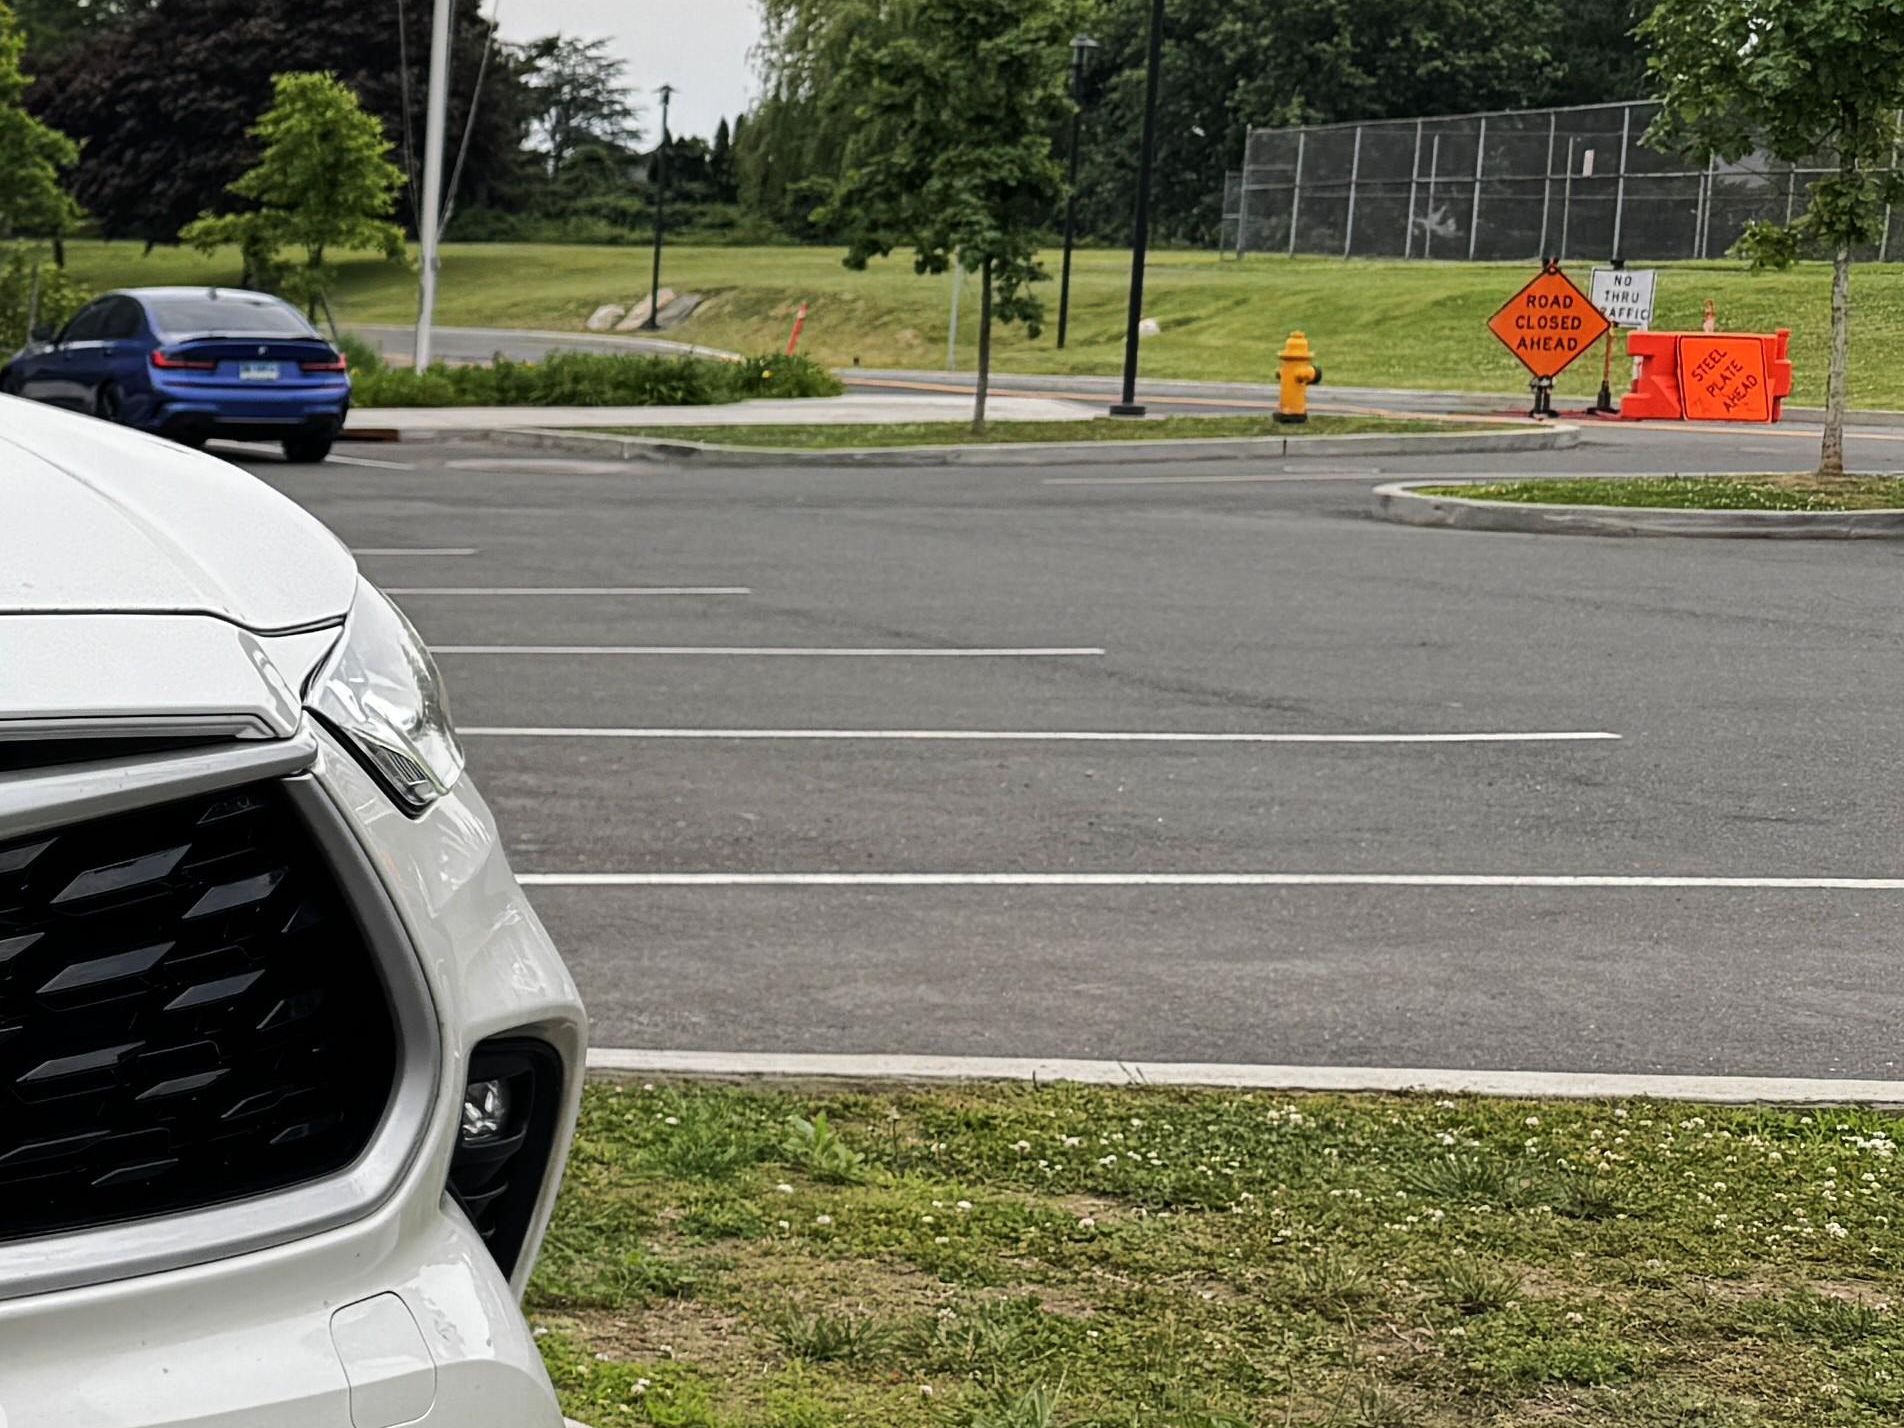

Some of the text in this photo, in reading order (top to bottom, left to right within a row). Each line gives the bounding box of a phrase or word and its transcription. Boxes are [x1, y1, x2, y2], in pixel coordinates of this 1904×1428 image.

[1614, 274, 1632, 287] NO
[1526, 294, 1574, 309] ROAD
[1604, 289, 1640, 304] THRU
[1599, 306, 1650, 321] RAFFIC
[1515, 315, 1582, 330] CLOSED
[1516, 337, 1578, 351] AHEAD
[1691, 349, 1727, 382] STEEL
[1706, 359, 1743, 397] PLATE
[1723, 374, 1758, 413] AHEAD
